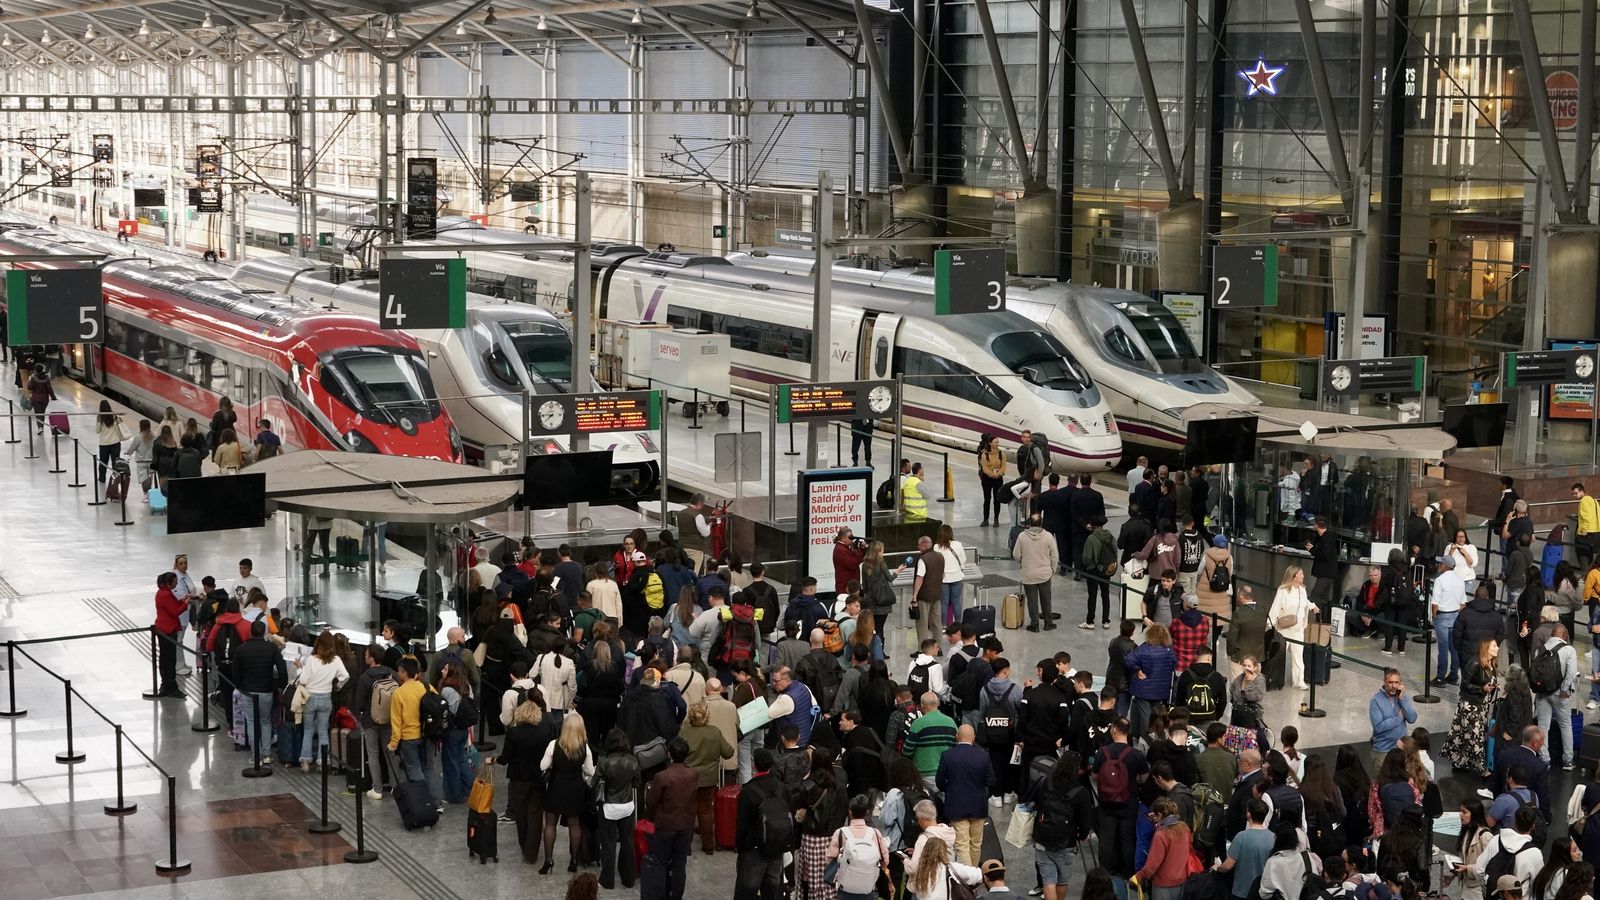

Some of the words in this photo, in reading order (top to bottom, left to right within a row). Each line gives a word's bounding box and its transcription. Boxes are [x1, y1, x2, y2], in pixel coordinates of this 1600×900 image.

[30, 274, 42, 282] Vía
[987, 281, 1002, 310] 3
[1218, 276, 1230, 304] 2
[385, 294, 406, 326] 4
[80, 306, 98, 339] 5
[660, 344, 679, 356] serveo
[832, 349, 854, 363] AVE
[812, 484, 847, 493] Lamine
[812, 493, 841, 504] saldrá
[844, 494, 860, 504] por
[811, 503, 846, 514] Madrid
[848, 505, 854, 513] y
[811, 514, 847, 524] dormirá
[986, 717, 1008, 726] VANS
